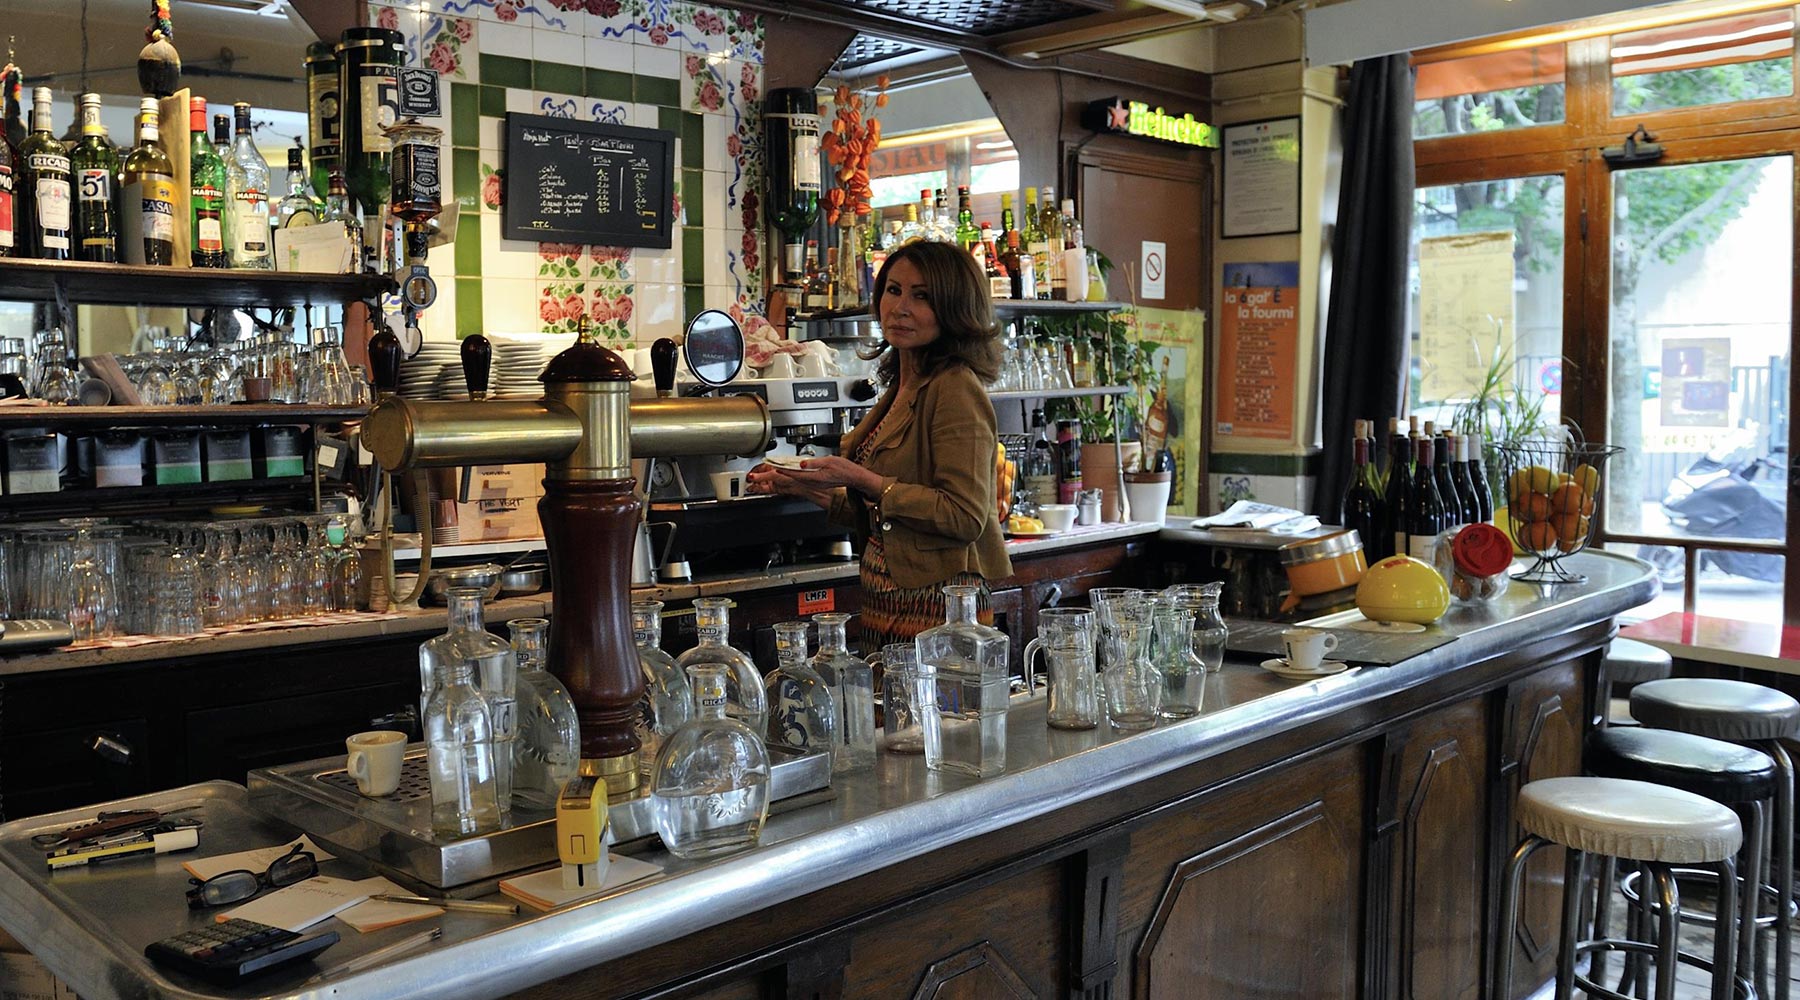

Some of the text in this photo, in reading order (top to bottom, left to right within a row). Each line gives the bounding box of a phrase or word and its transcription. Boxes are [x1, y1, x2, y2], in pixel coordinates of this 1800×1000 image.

[82, 175, 108, 197] 51
[1237, 306, 1294, 319] la fourmi
